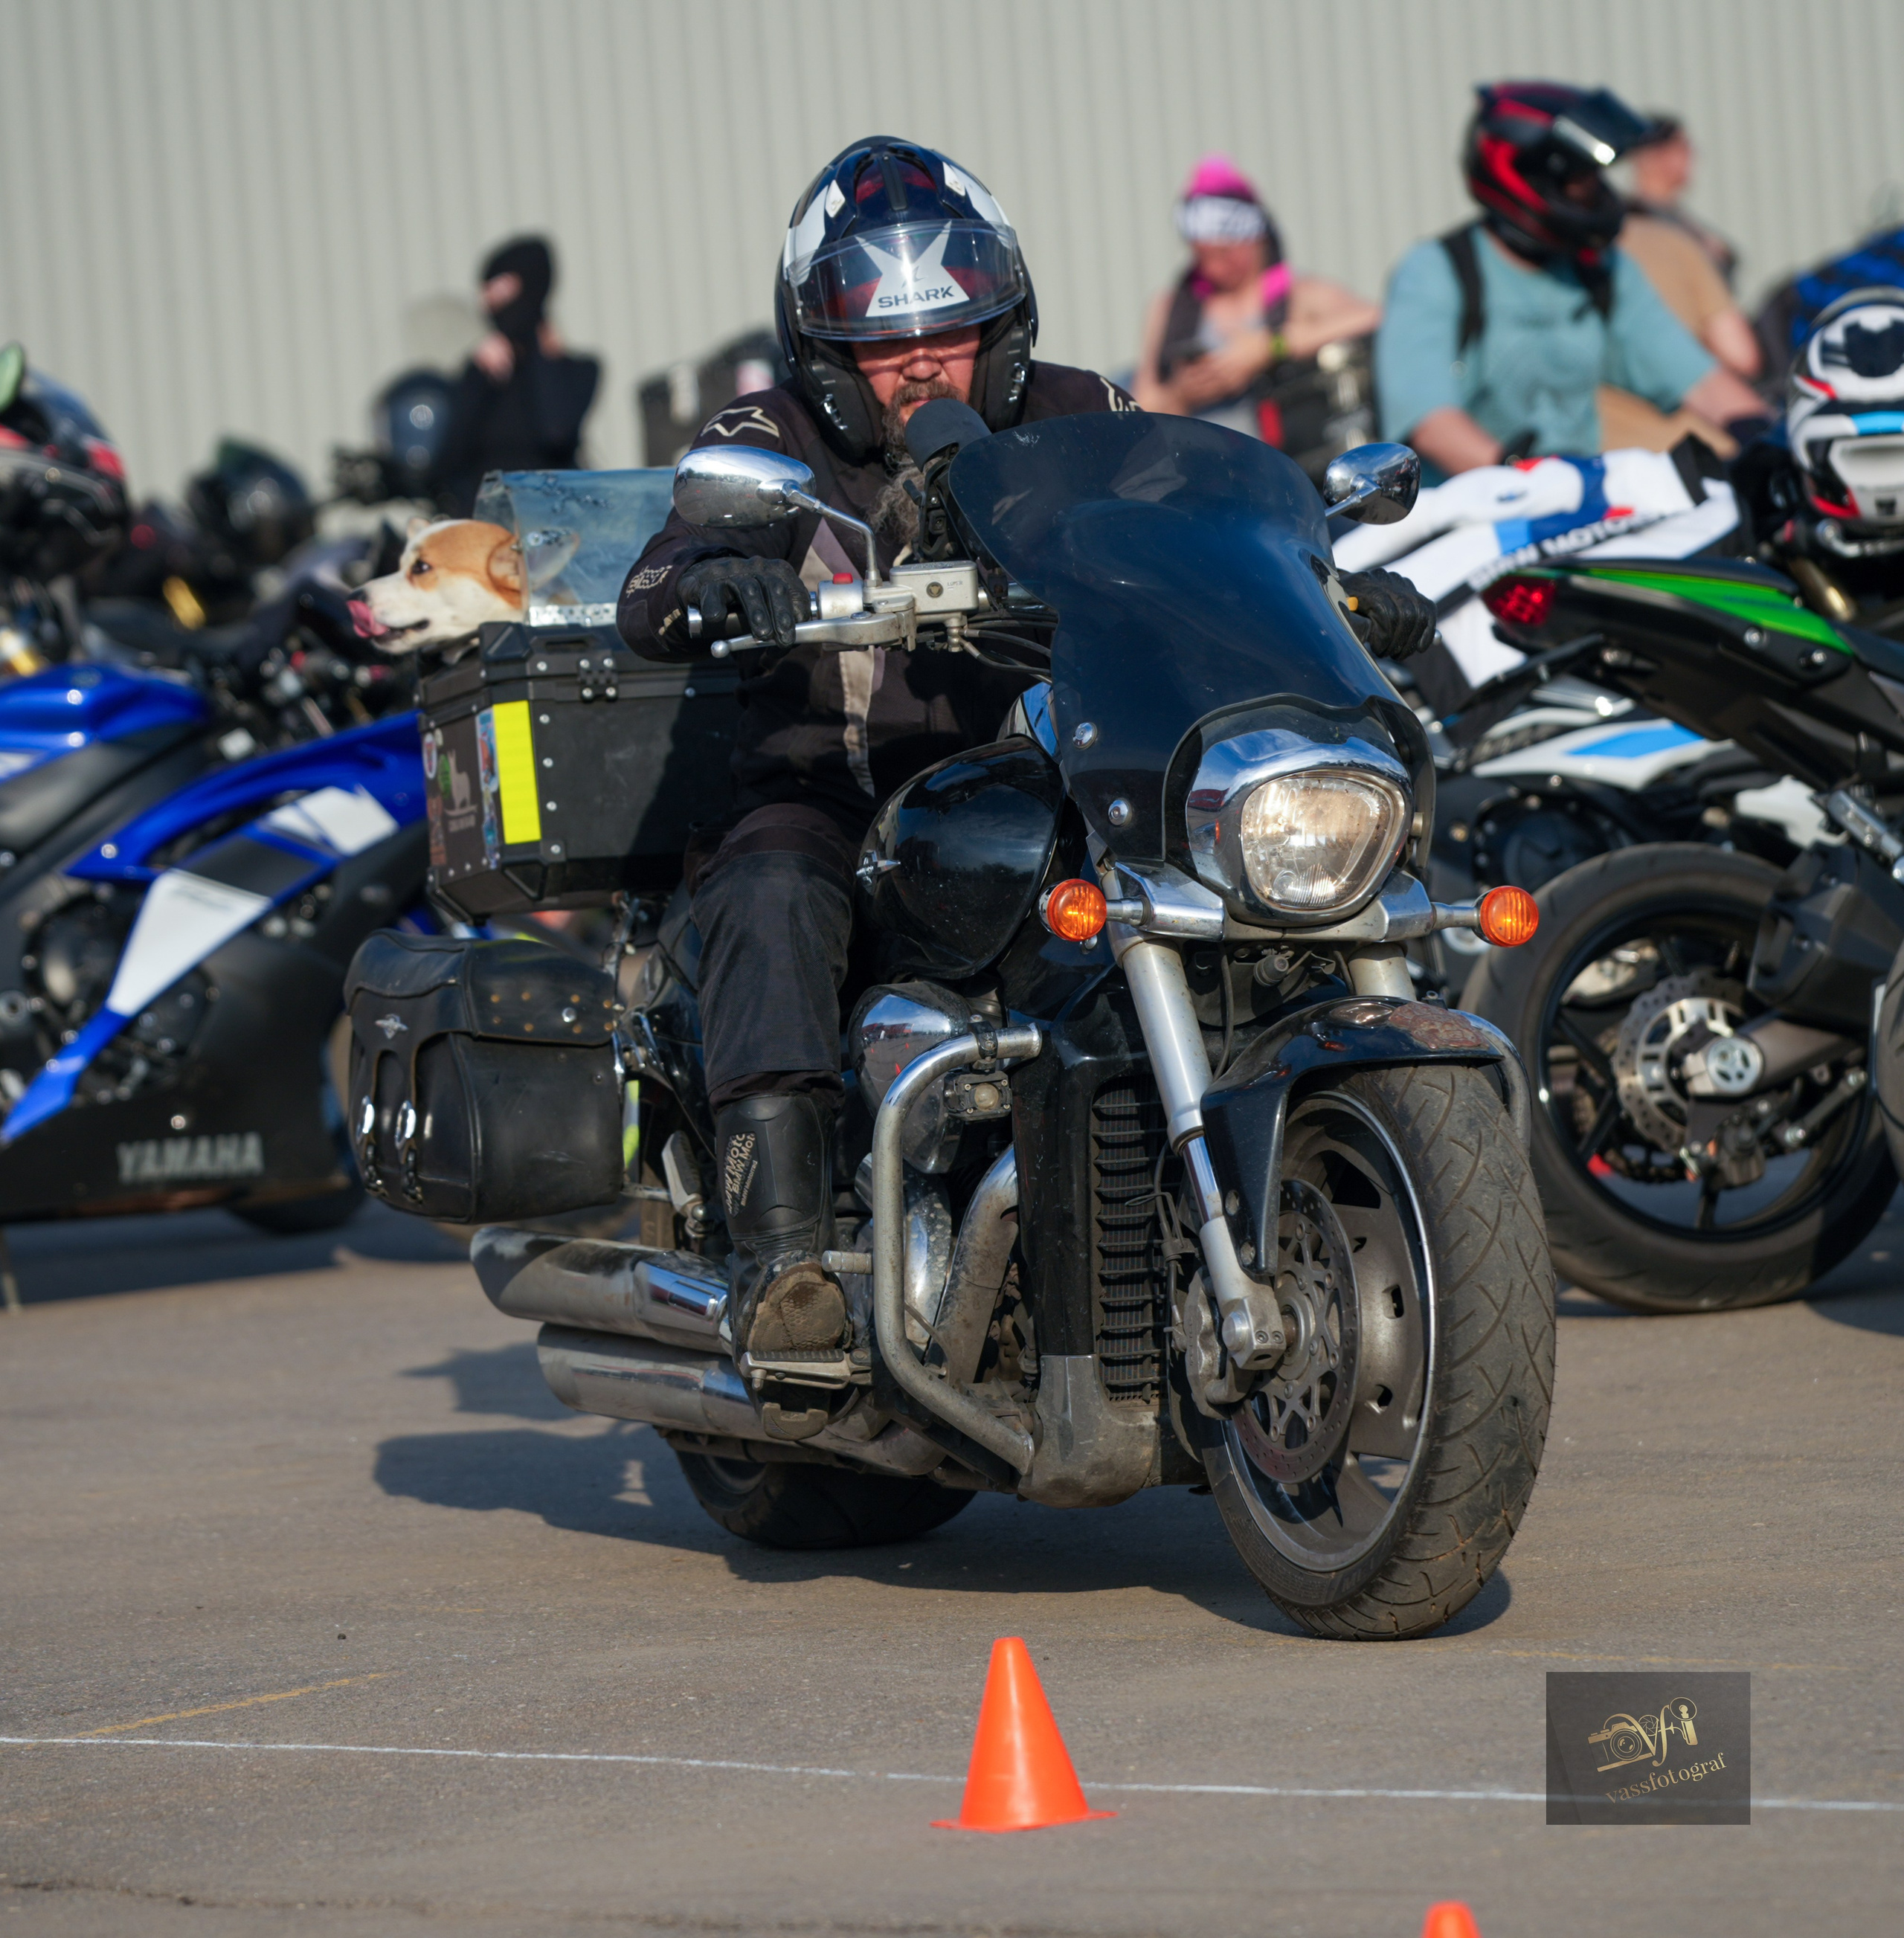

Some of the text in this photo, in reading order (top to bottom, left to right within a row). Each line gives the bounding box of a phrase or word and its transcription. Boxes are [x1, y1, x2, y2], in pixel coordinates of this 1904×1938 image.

[878, 286, 955, 309] SHARK
[115, 1131, 264, 1183] YAMAHA
[732, 1159, 745, 1194] BMW
[744, 1160, 758, 1189] Motorrad
